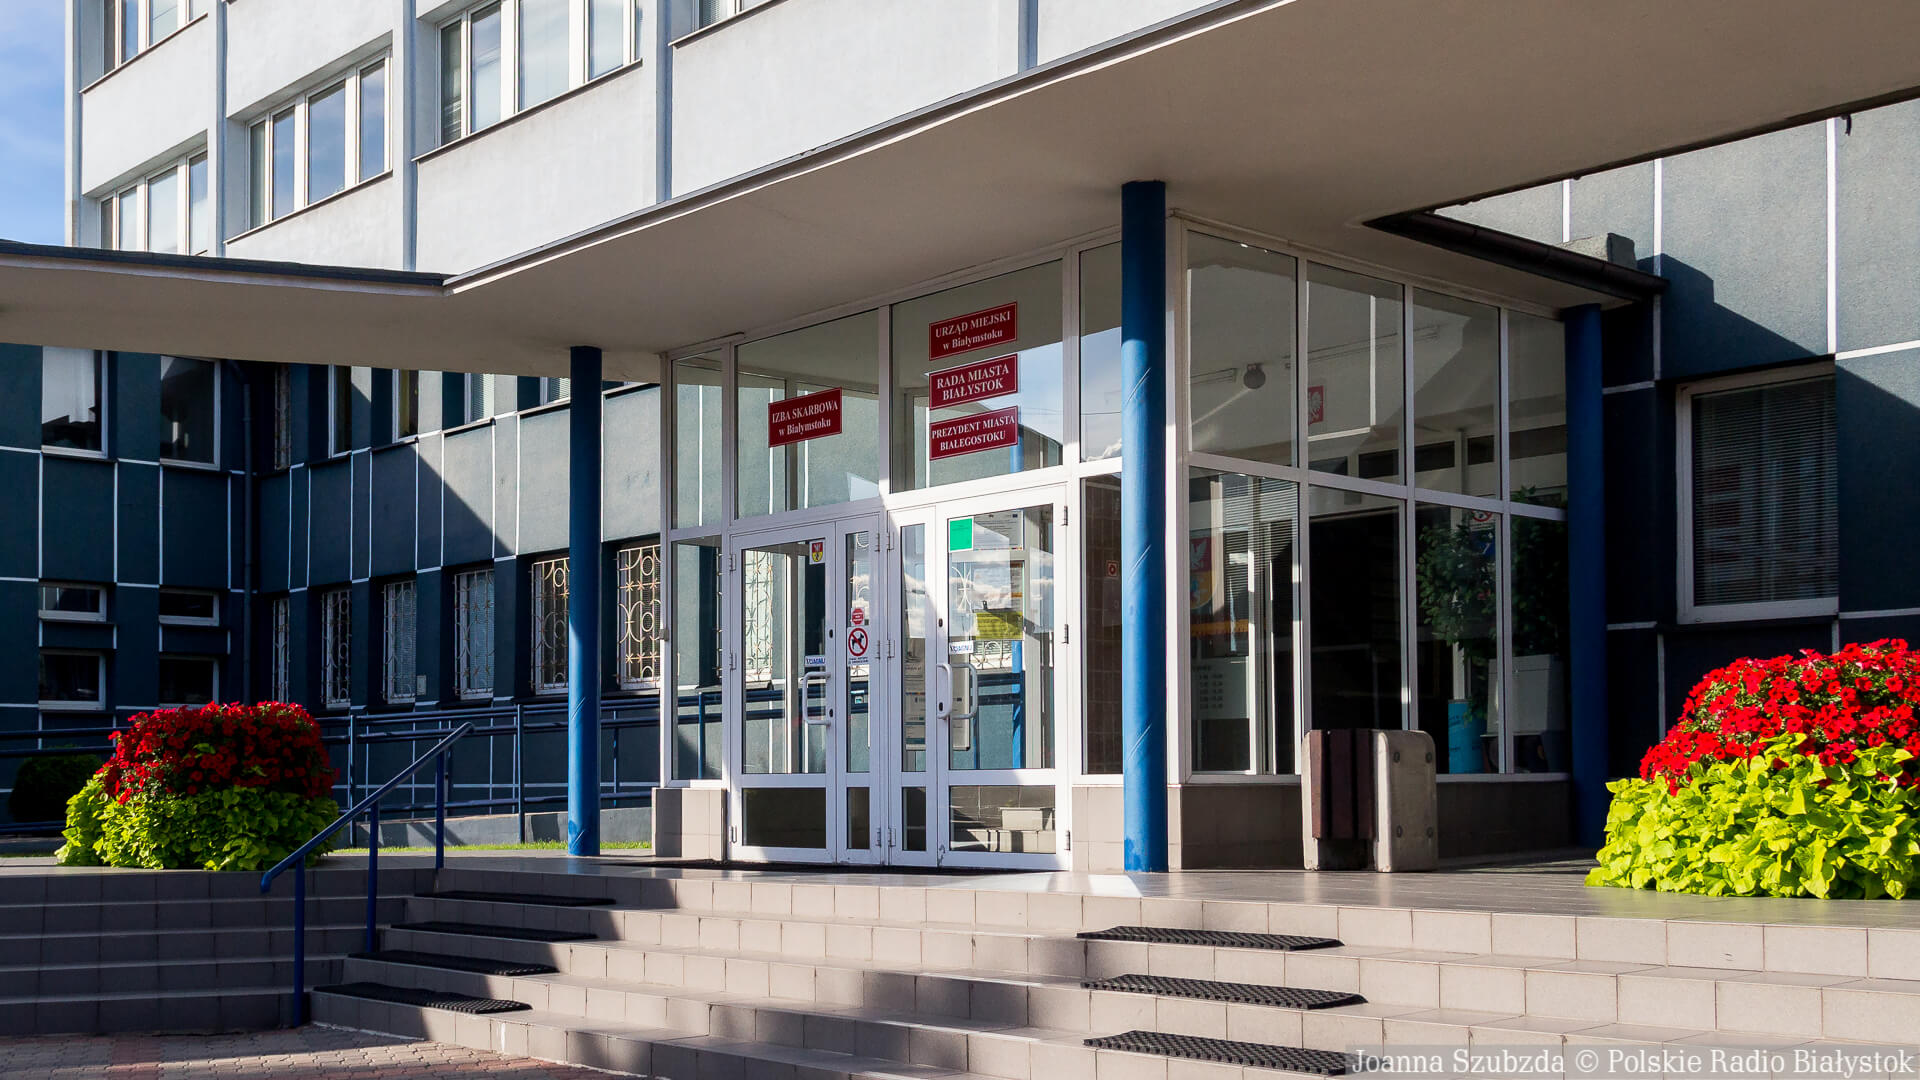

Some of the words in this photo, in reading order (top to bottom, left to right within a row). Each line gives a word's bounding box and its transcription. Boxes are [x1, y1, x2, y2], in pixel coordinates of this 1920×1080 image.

[935, 321, 968, 338] URZĄD
[970, 311, 1011, 330] MIEJSKI
[942, 342, 950, 351] w
[951, 329, 1003, 348] Białymstoku
[936, 373, 965, 389] RADA
[967, 363, 1009, 382] MIASTA
[943, 378, 1003, 401] BIAŁYSTOK
[772, 411, 791, 424] IZBA
[791, 400, 838, 420] SKARBOWA
[778, 428, 785, 436] w
[786, 417, 831, 435] Białymstoku
[931, 421, 981, 440] PREZYDENT
[982, 415, 1015, 429] MIASTA
[940, 430, 1006, 451] BIAŁEGOSTOKU
